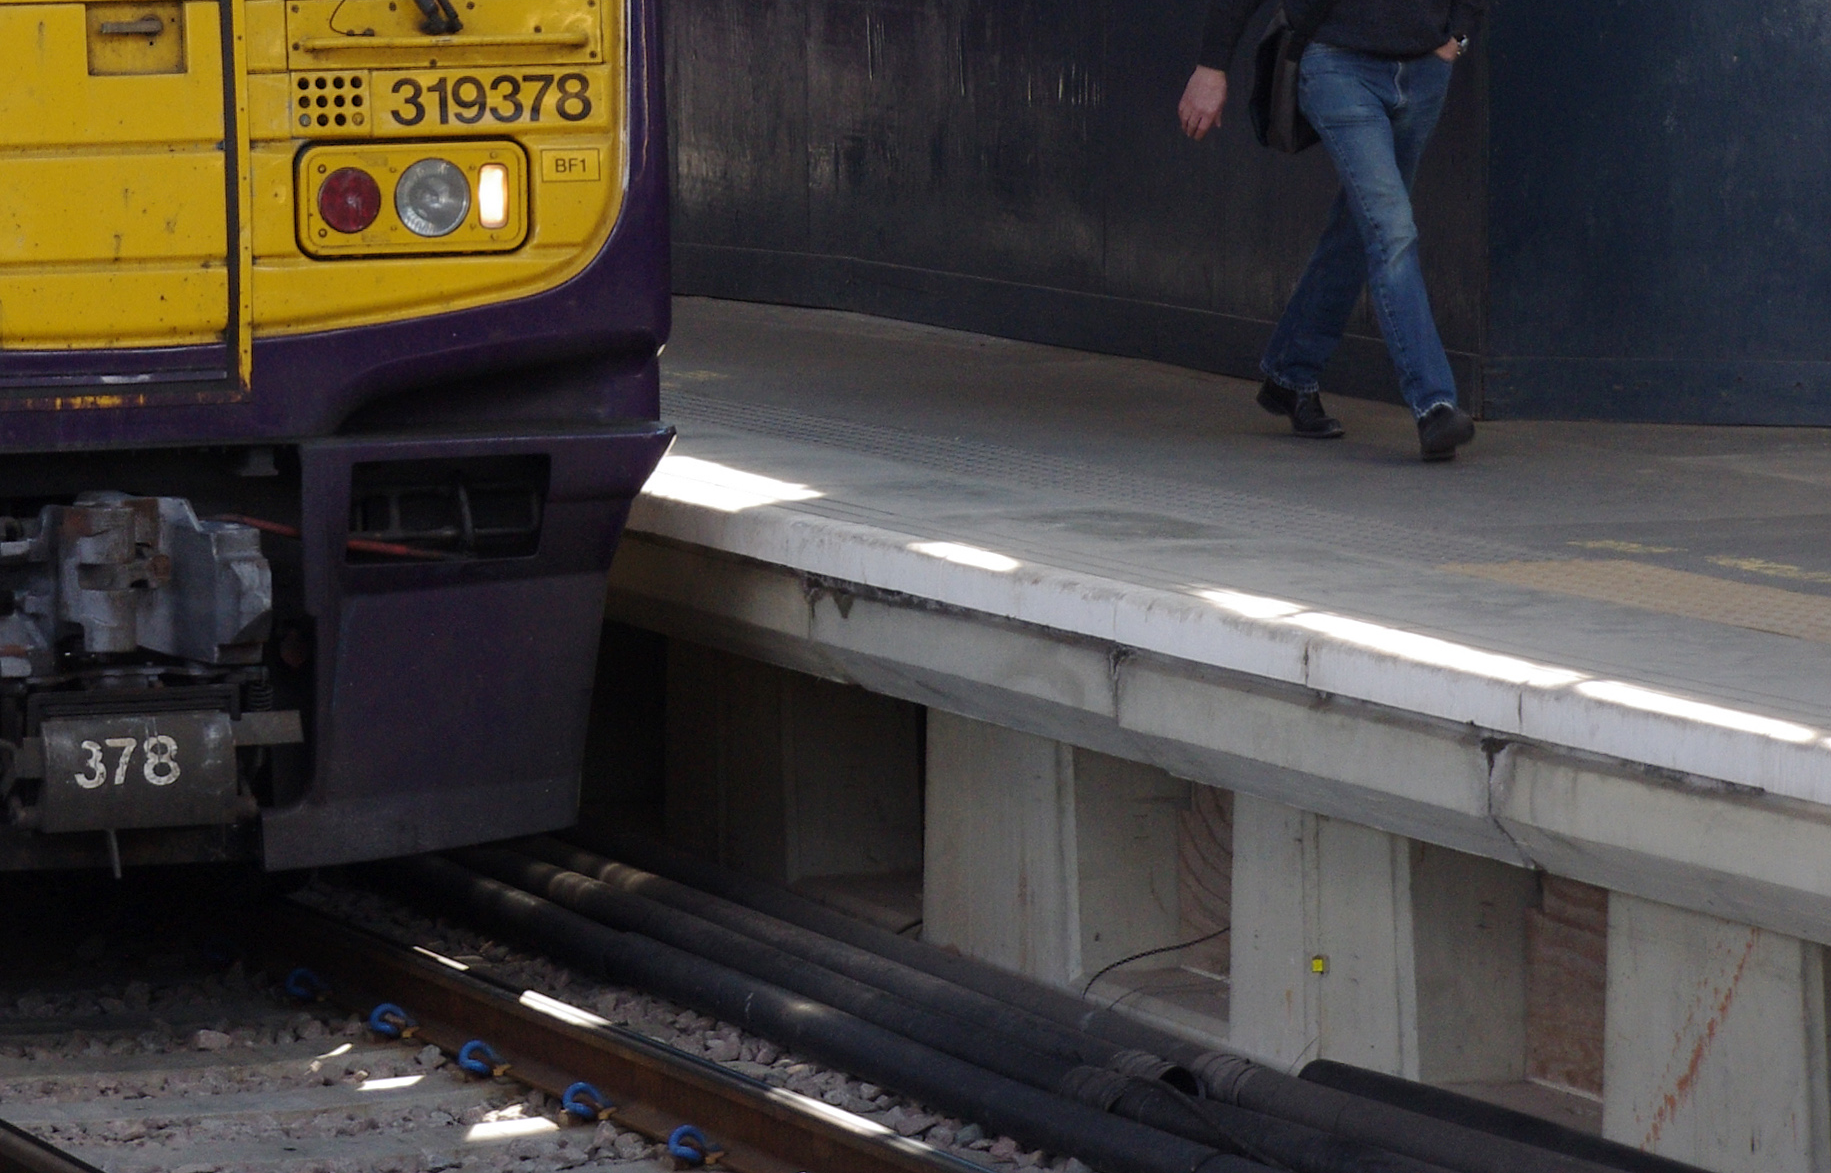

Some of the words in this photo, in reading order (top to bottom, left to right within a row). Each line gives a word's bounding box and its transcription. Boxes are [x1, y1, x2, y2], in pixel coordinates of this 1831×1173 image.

[390, 73, 592, 126] 319378
[555, 158, 588, 173] BF1
[74, 735, 181, 789] 378
